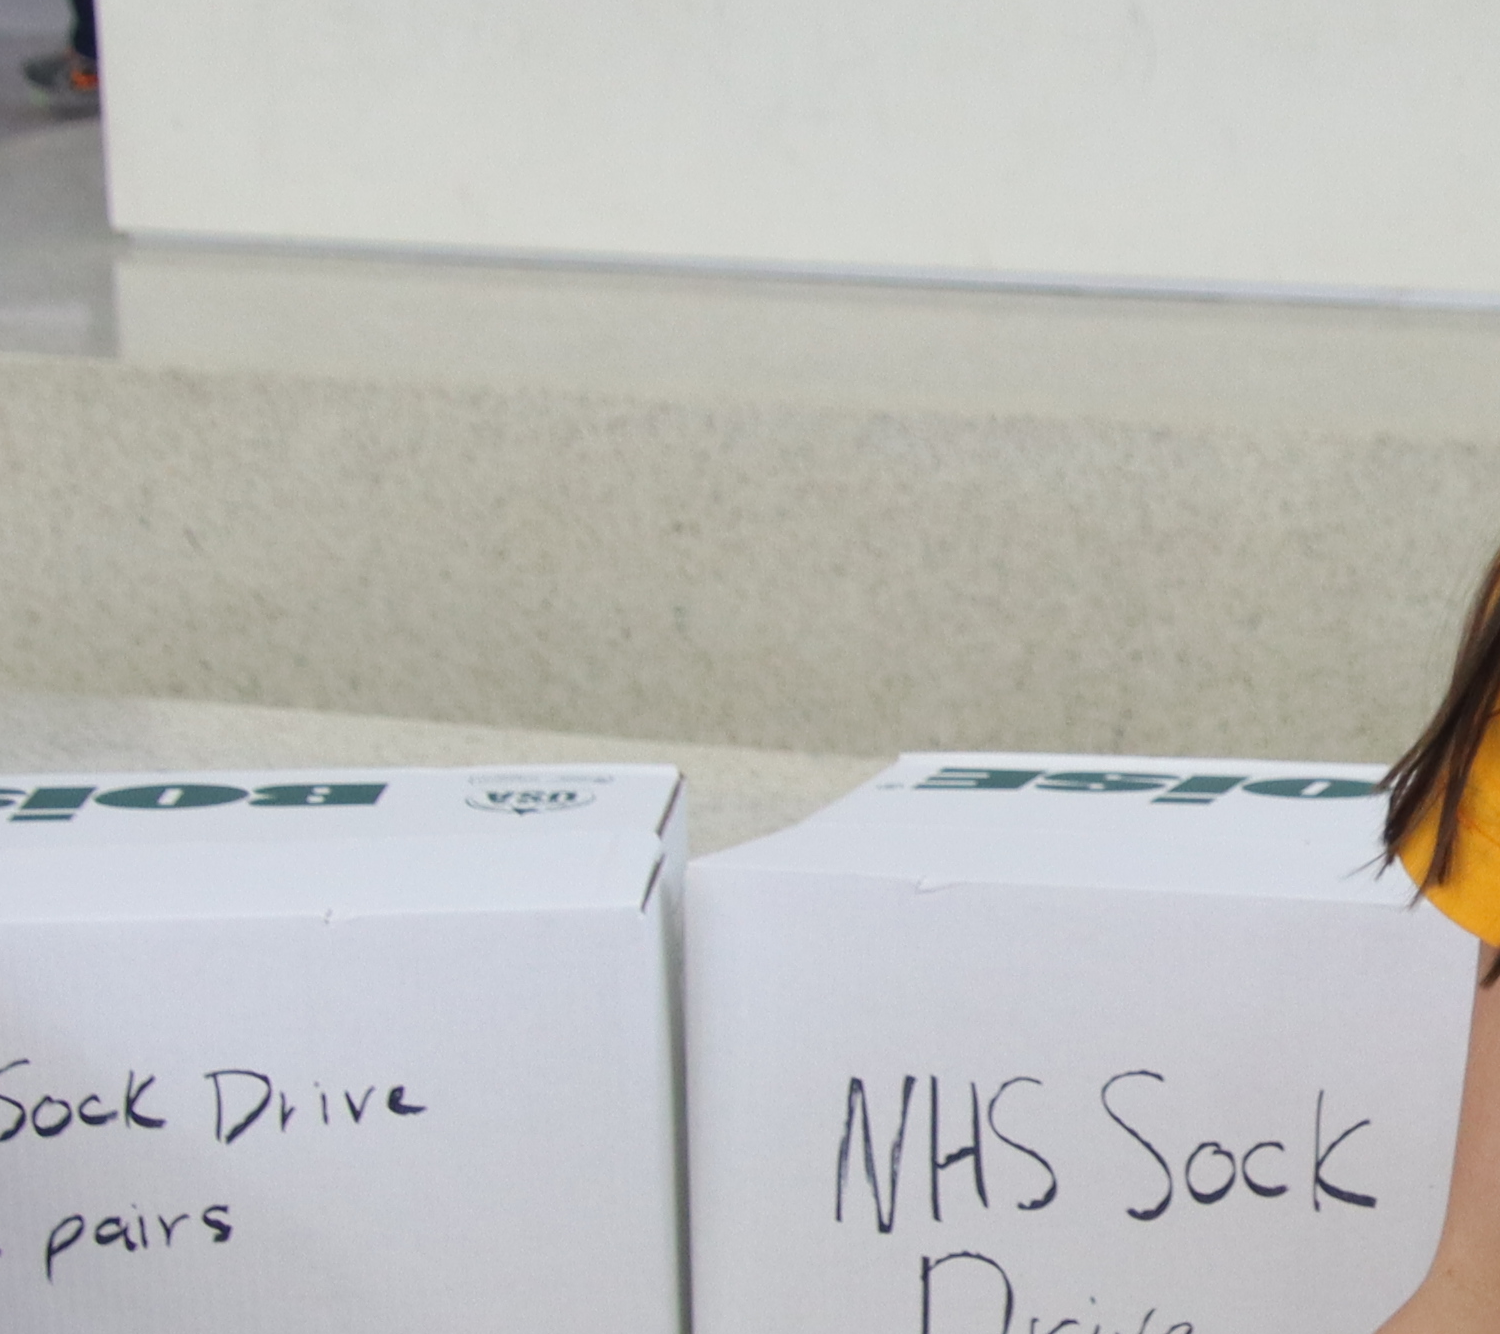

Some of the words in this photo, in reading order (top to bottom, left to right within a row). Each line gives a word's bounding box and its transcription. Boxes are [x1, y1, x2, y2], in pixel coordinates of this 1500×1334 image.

[912, 767, 1380, 805] OISE
[203, 1068, 430, 1146] Drive
[833, 1074, 1059, 1235] NHS
[1100, 1068, 1378, 1223] Sock
[43, 1202, 236, 1280] pairs
